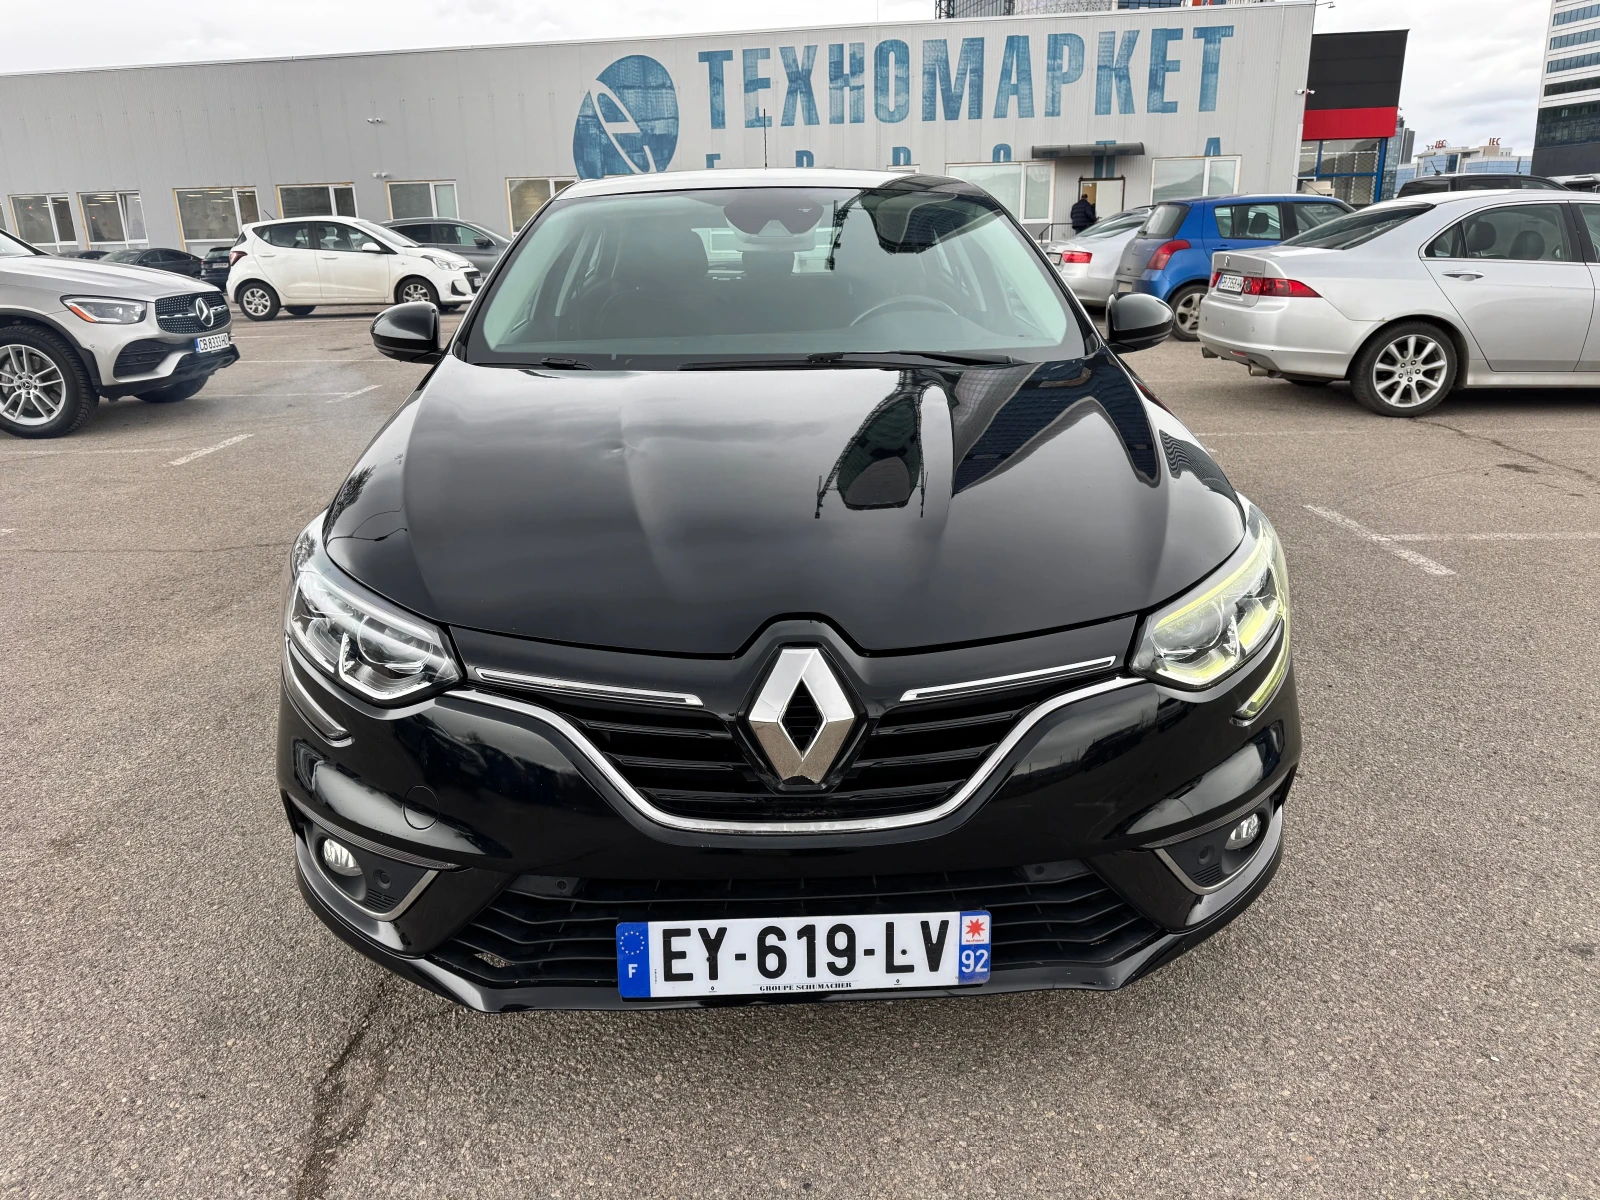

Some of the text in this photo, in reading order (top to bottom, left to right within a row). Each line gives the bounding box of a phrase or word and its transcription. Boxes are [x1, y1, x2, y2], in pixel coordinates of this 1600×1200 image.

[698, 25, 1235, 129] ТЕХНОМАРКЕТ
[1489, 137, 1501, 146] IEC
[662, 919, 949, 983] EY-619-LV
[628, 963, 638, 978] F
[961, 949, 989, 973] 92
[759, 982, 852, 992] GROUPE SCHUMACHER
